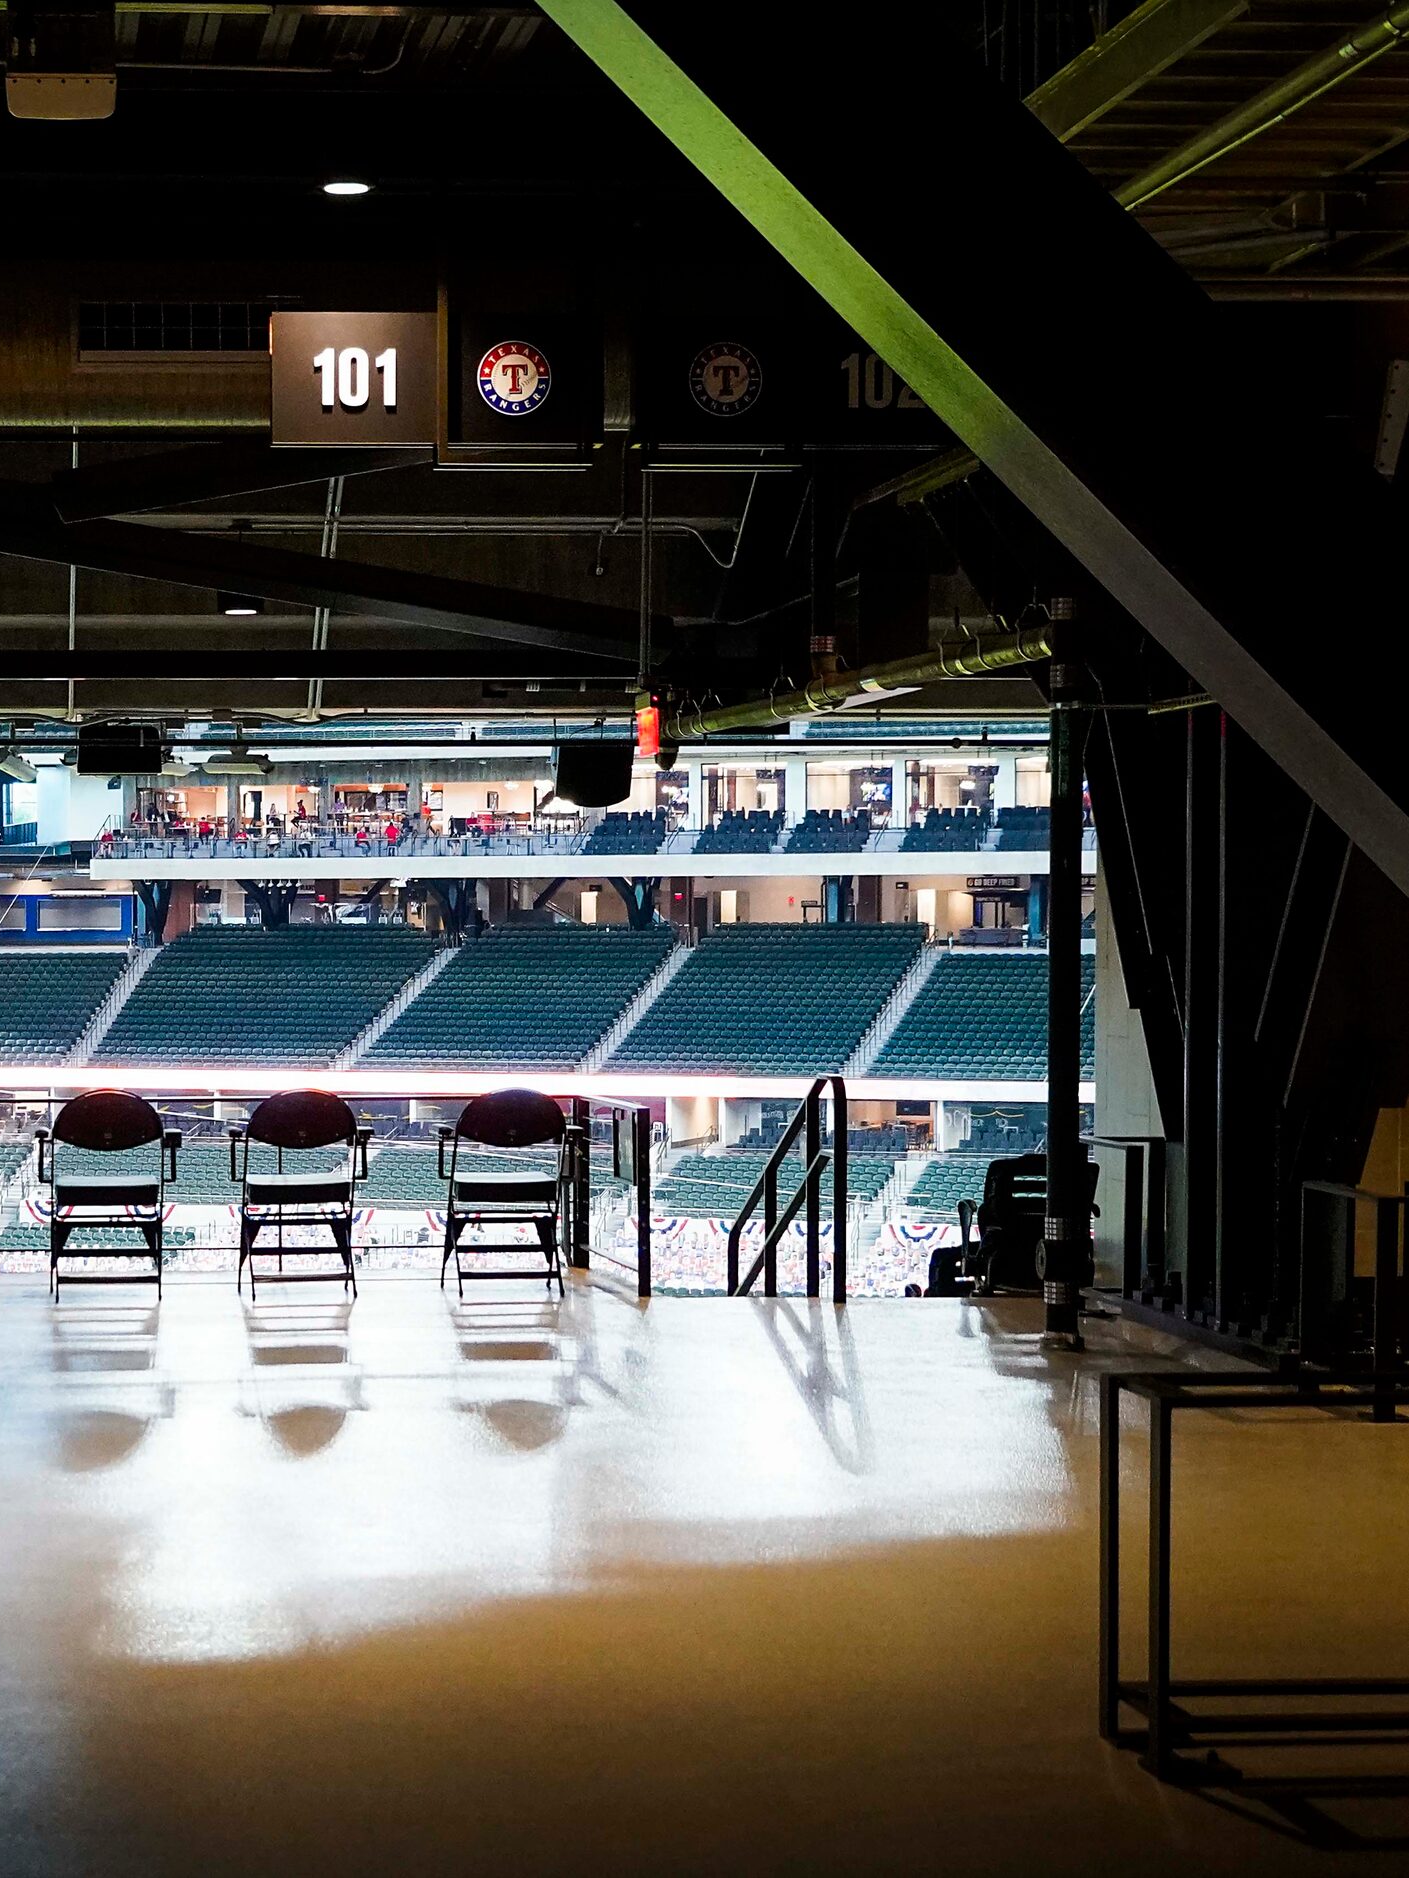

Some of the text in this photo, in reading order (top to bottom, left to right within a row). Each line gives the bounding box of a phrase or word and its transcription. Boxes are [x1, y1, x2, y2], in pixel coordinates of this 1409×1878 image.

[487, 344, 542, 364] TEXAS
[700, 346, 752, 364] TEXAS
[313, 347, 397, 407] 101
[501, 363, 529, 395] T
[712, 365, 740, 396] T
[483, 382, 546, 411] RANGERS
[695, 384, 756, 412] RANGERS
